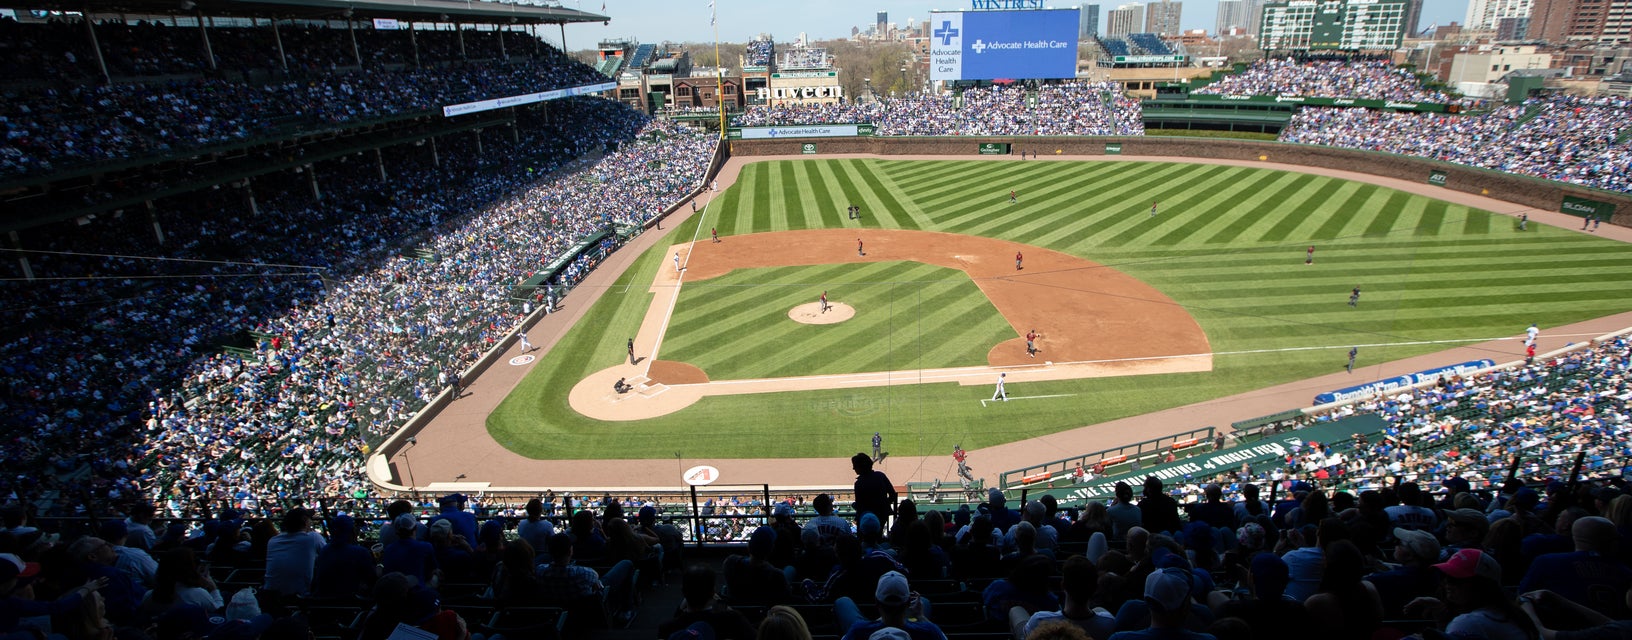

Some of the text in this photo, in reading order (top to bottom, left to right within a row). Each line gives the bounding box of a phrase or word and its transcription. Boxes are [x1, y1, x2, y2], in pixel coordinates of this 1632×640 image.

[972, 0, 1044, 10] WINTRUST
[987, 39, 1068, 50] Advocate Health Care
[935, 57, 957, 65] Health
[938, 65, 953, 73] Care
[756, 85, 843, 99] nuveen
[1563, 201, 1595, 213] SLOAN
[1074, 487, 1101, 499] THE
[1097, 474, 1148, 494] FRNDLY
[1203, 459, 1216, 469] of
[1210, 448, 1257, 466] WRIGLEY
[1252, 442, 1285, 455] FIELD
